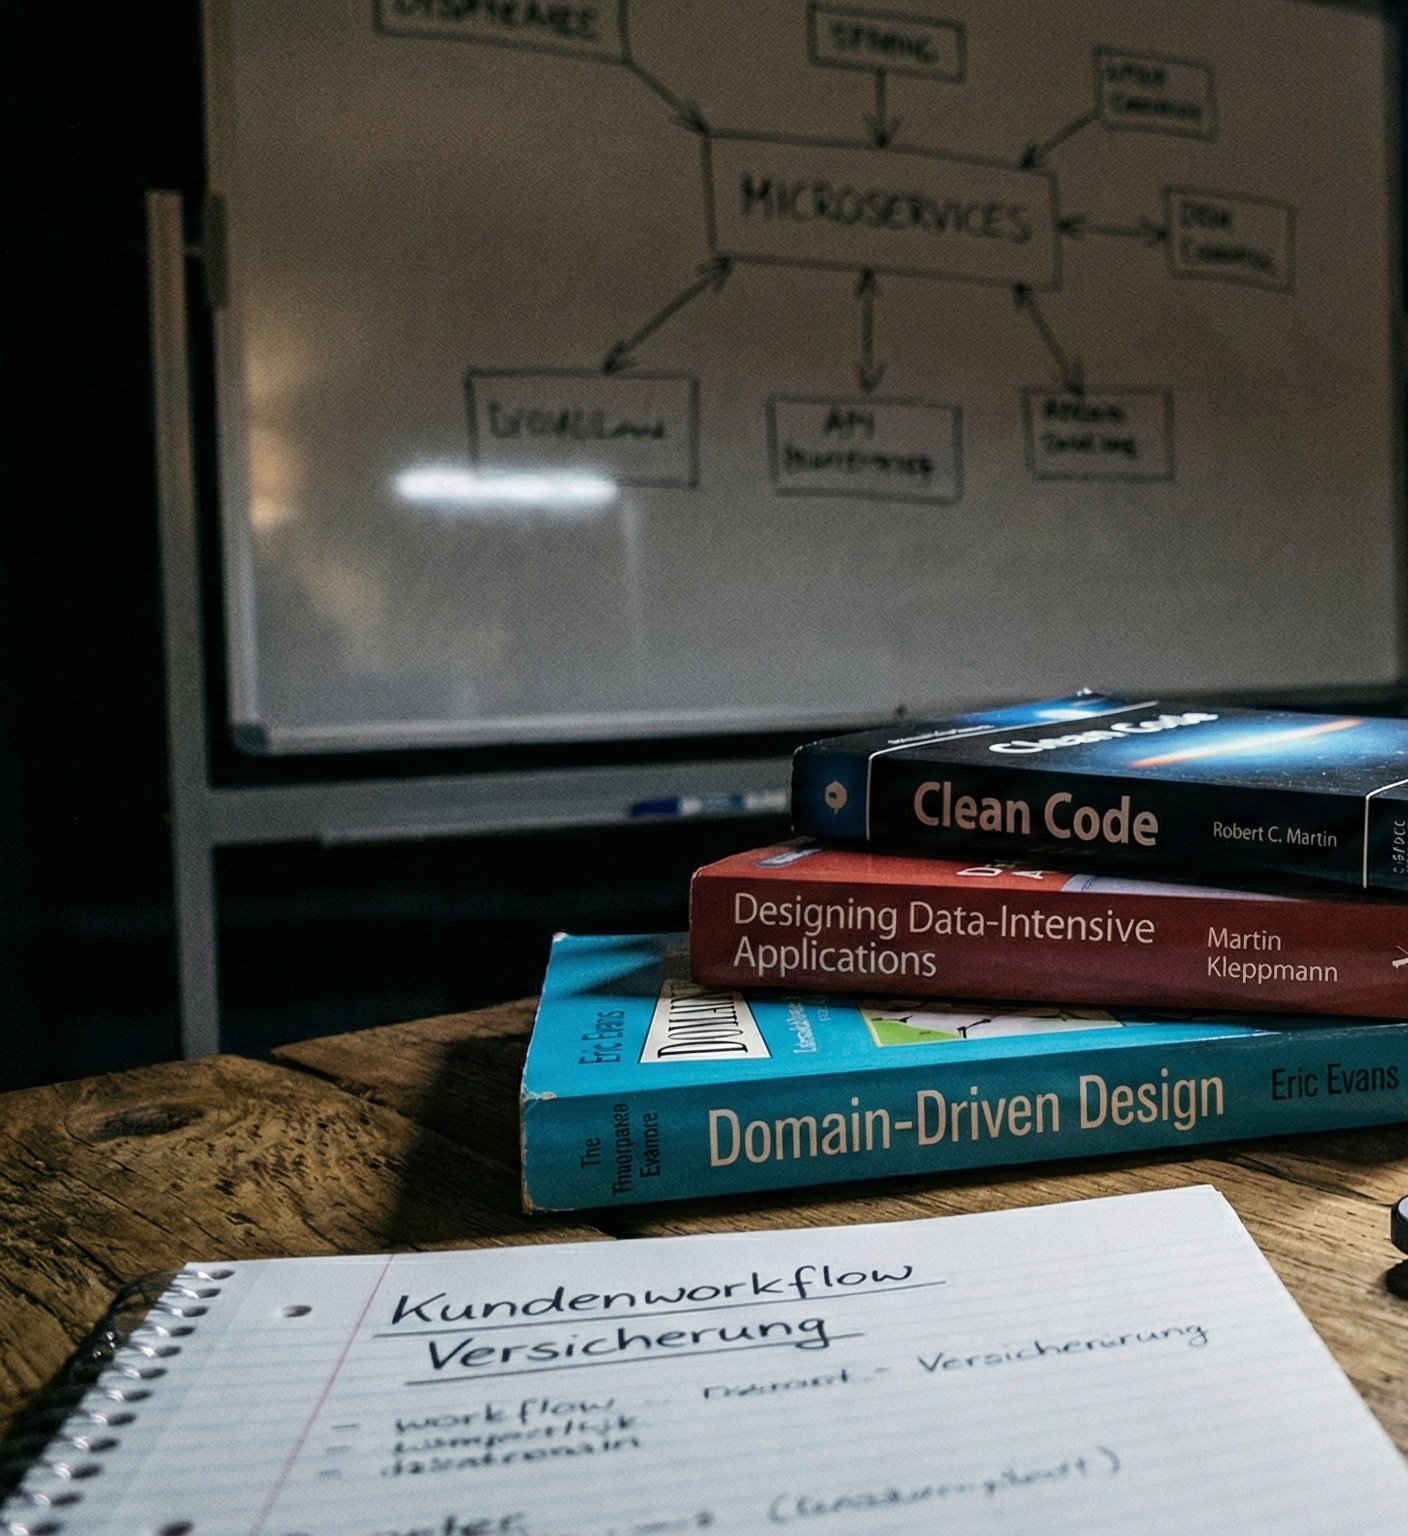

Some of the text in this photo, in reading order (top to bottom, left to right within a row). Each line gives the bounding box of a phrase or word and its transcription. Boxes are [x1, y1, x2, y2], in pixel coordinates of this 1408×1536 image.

[741, 170, 1034, 245] MICROSERVICES
[913, 781, 1159, 846] Clean Code
[1213, 822, 1338, 848] Robert C. Martin
[734, 892, 1156, 945] Designing Data-Intensive
[1207, 927, 1282, 951] Martin
[733, 936, 938, 978] Applications
[1207, 956, 1338, 984] Kleppmann
[579, 1042, 622, 1065] Eric
[1271, 1063, 1399, 1101] Eric Evans
[708, 1068, 1225, 1168] Domain-Driven Design
[581, 1137, 601, 1170] The
[392, 1265, 914, 1325] Kundenworkflow
[428, 1316, 832, 1370] Versicherung
